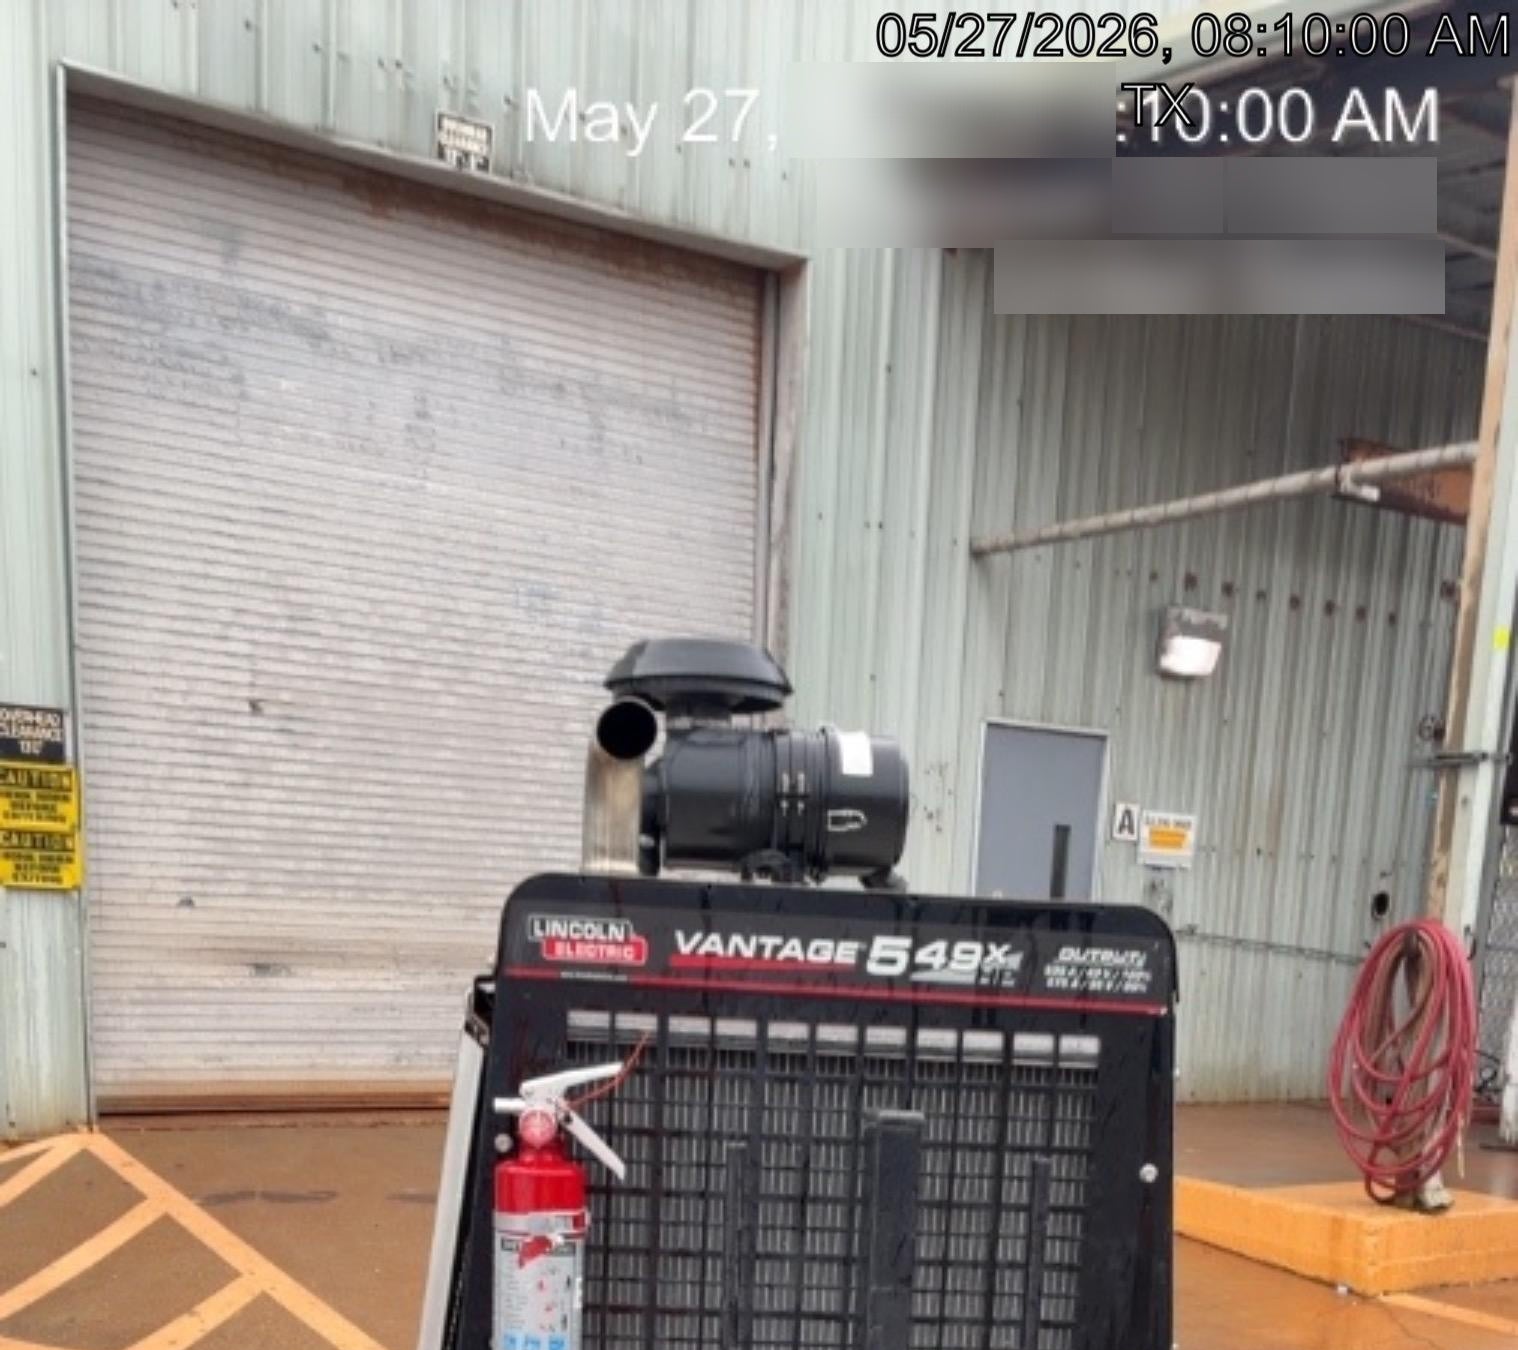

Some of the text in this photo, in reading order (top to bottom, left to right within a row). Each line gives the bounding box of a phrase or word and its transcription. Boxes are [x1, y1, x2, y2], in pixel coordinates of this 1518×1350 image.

[1118, 809, 1135, 835] A
[533, 919, 625, 942] LINCOLN
[554, 941, 634, 960] ELECTRIC
[674, 930, 860, 964] VANTAGE
